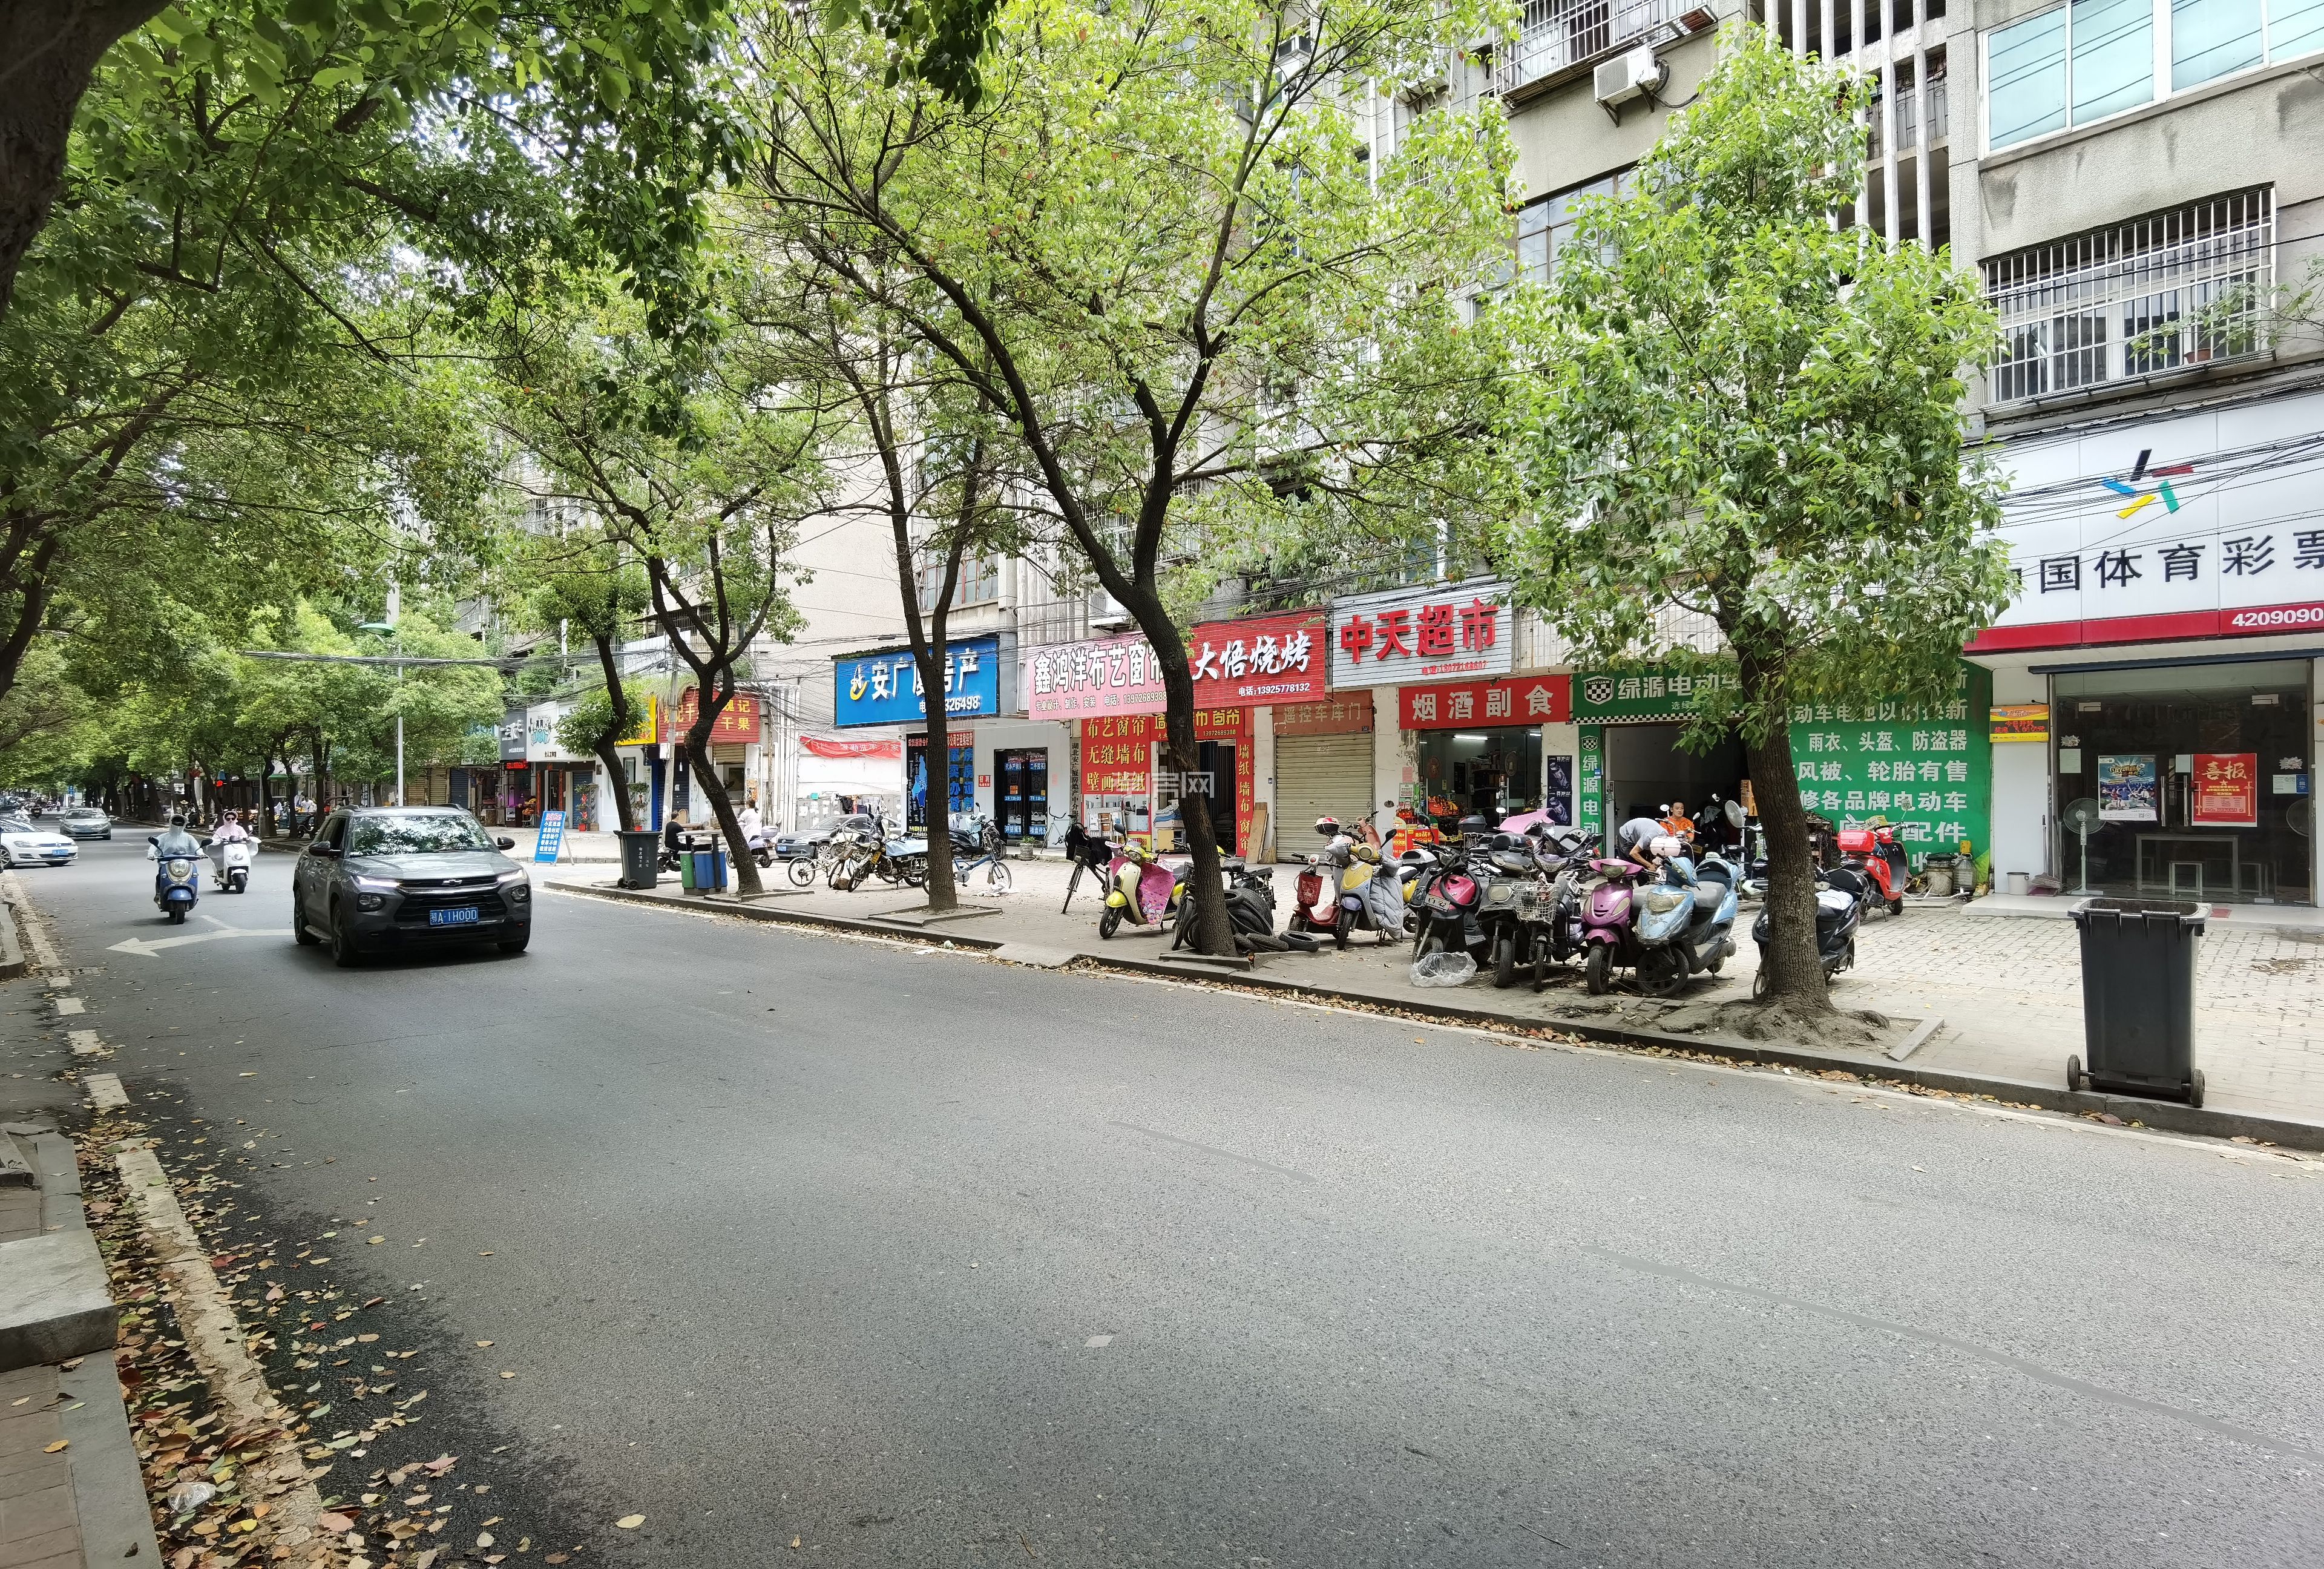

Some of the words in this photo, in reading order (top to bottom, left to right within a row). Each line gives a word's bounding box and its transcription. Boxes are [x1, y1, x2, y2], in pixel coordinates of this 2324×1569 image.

[1341, 597, 1499, 664] 中天超市
[1192, 630, 1312, 680] 大悟烧烤
[1284, 702, 1361, 723] 遥控车库门
[1413, 685, 1554, 721] 烟酒副食
[1787, 698, 1968, 724] 动车电池以换新
[721, 717, 750, 731] 干果
[1086, 716, 1146, 739] 布艺窗帘
[1788, 729, 1968, 752] 、雨衣、头盔、防盗器
[1086, 742, 1146, 765] 无缝墙布
[1238, 744, 1250, 775] 墙纸
[1086, 771, 1146, 792] 壁画墙纸
[1791, 760, 1968, 782] 风被、轮胎有售
[2201, 760, 2247, 780] 喜报
[1239, 781, 1250, 813] 墙布
[1582, 755, 1599, 834] 绿源电动
[1239, 818, 1250, 851] 窗帘
